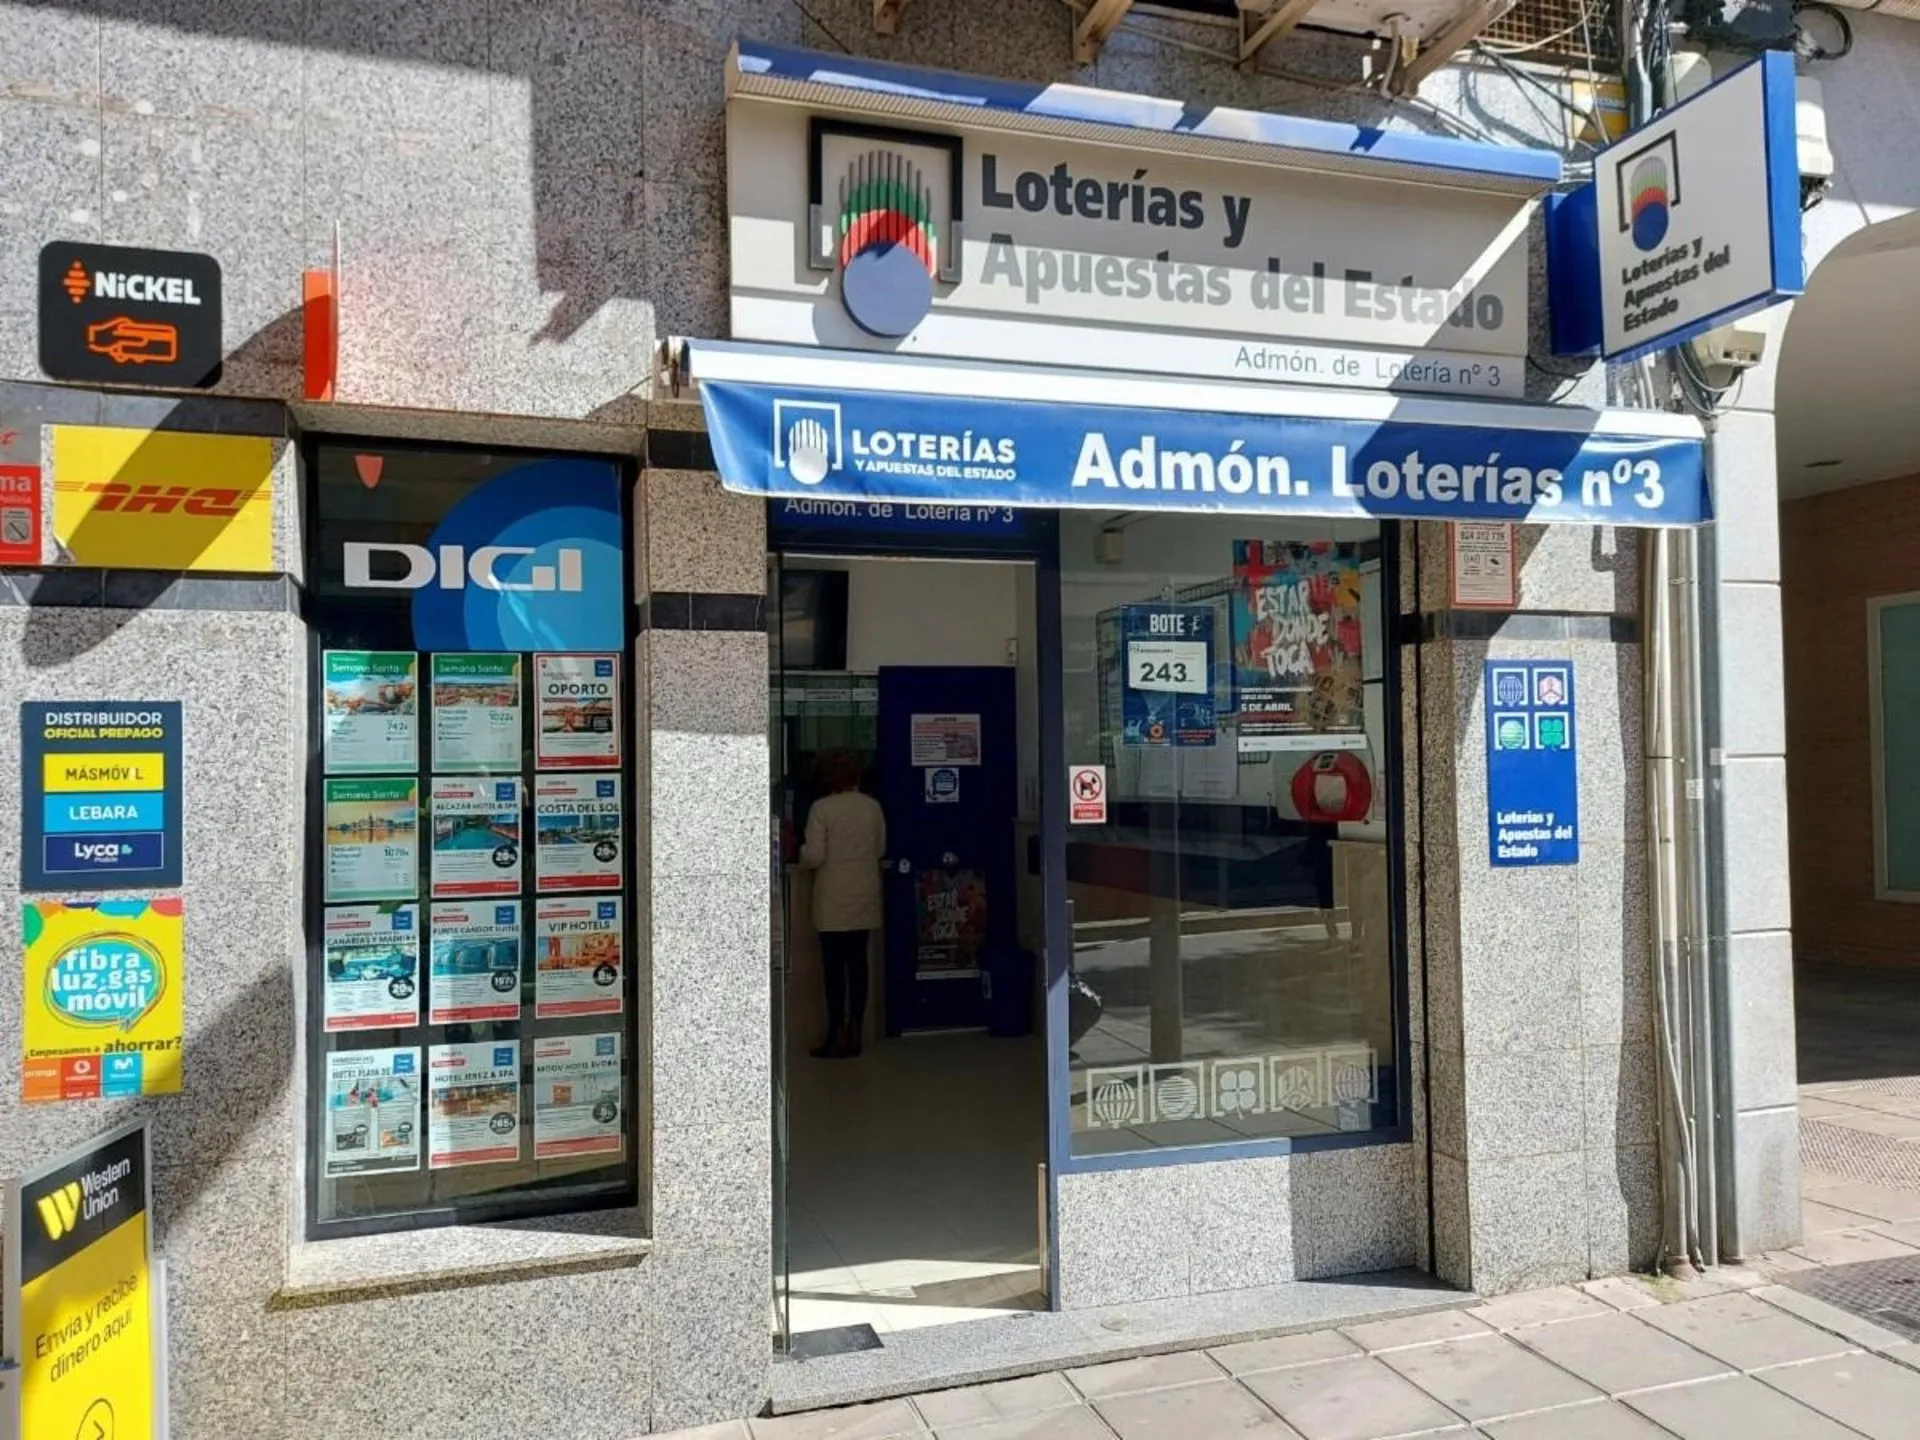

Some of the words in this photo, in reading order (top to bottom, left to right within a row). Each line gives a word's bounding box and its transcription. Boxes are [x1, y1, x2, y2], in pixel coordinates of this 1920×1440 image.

[982, 153, 1204, 229] Loterías
[1222, 195, 1252, 248] y
[1692, 236, 1702, 258] y
[980, 232, 1232, 306] Apuestas
[1250, 257, 1325, 314] del
[1344, 269, 1504, 330] Estado
[1624, 263, 1699, 309] Apuestas
[1703, 245, 1730, 274] del
[1623, 297, 1678, 332] Estado
[1235, 346, 1324, 374] Admón.
[1333, 356, 1360, 376] de
[1375, 357, 1450, 383] Lotería
[1488, 366, 1500, 387] 3
[852, 429, 1016, 464] LOTERÍAS
[855, 459, 865, 472] Y
[866, 461, 934, 477] APUESTAS
[936, 465, 961, 478] DEL
[964, 467, 1017, 481] ESTADO
[1072, 432, 1309, 497] Admón.
[1332, 445, 1563, 508] Loterías
[1002, 505, 1014, 523] 3
[343, 542, 582, 591] DIGI
[1255, 580, 1311, 621] ESTAR
[1150, 614, 1185, 633] BOTE
[1274, 612, 1331, 646] DONDE
[332, 663, 370, 673] Semana
[372, 664, 399, 673] Santa
[1261, 645, 1315, 678] TOCA
[1140, 663, 1187, 683] 243
[548, 683, 608, 695] OPORTO
[45, 711, 163, 726] DISTRIBUIDOR
[1249, 703, 1262, 711] DE
[1264, 703, 1293, 712] ABRIL
[44, 727, 97, 740] OFICIAL
[99, 727, 164, 740] PREPAGO
[332, 791, 371, 800] Semana
[69, 805, 139, 820] LEBARA
[537, 803, 576, 813] COSTA
[577, 803, 596, 813] DEL
[599, 802, 619, 812] SOL
[1546, 812, 1554, 826] y
[1498, 827, 1551, 843] Apuestas
[1554, 826, 1573, 839] del
[75, 842, 119, 860] Lyca
[1498, 844, 1538, 859] Estado
[548, 921, 568, 932] VIP
[569, 920, 610, 931] HOTELS
[64, 948, 140, 972] fibra
[67, 985, 146, 1012] móvil
[104, 1036, 182, 1054] ahorrar?
[81, 1157, 131, 1194] Western
[83, 1187, 119, 1220] Union
[85, 1307, 94, 1333] y
[51, 1333, 101, 1383] dinero
